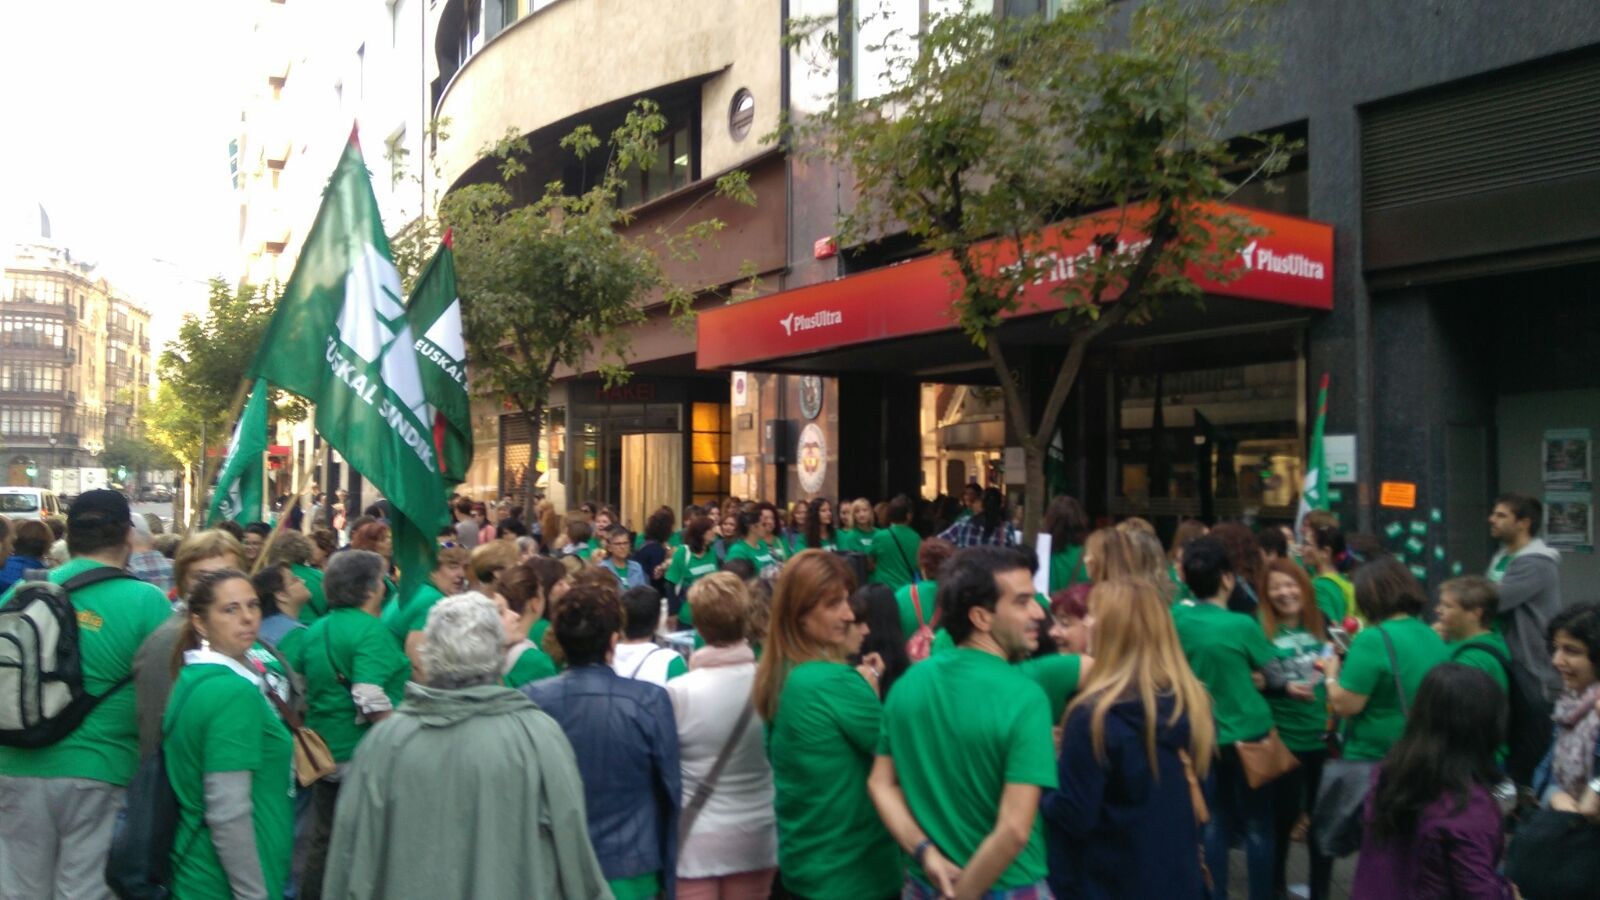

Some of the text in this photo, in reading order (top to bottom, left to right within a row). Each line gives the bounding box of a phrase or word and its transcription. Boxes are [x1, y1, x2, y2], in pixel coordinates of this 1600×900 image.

[1257, 248, 1324, 280] PlusUltra
[794, 310, 842, 332] PlusUltra
[415, 339, 462, 383] EUSKAL
